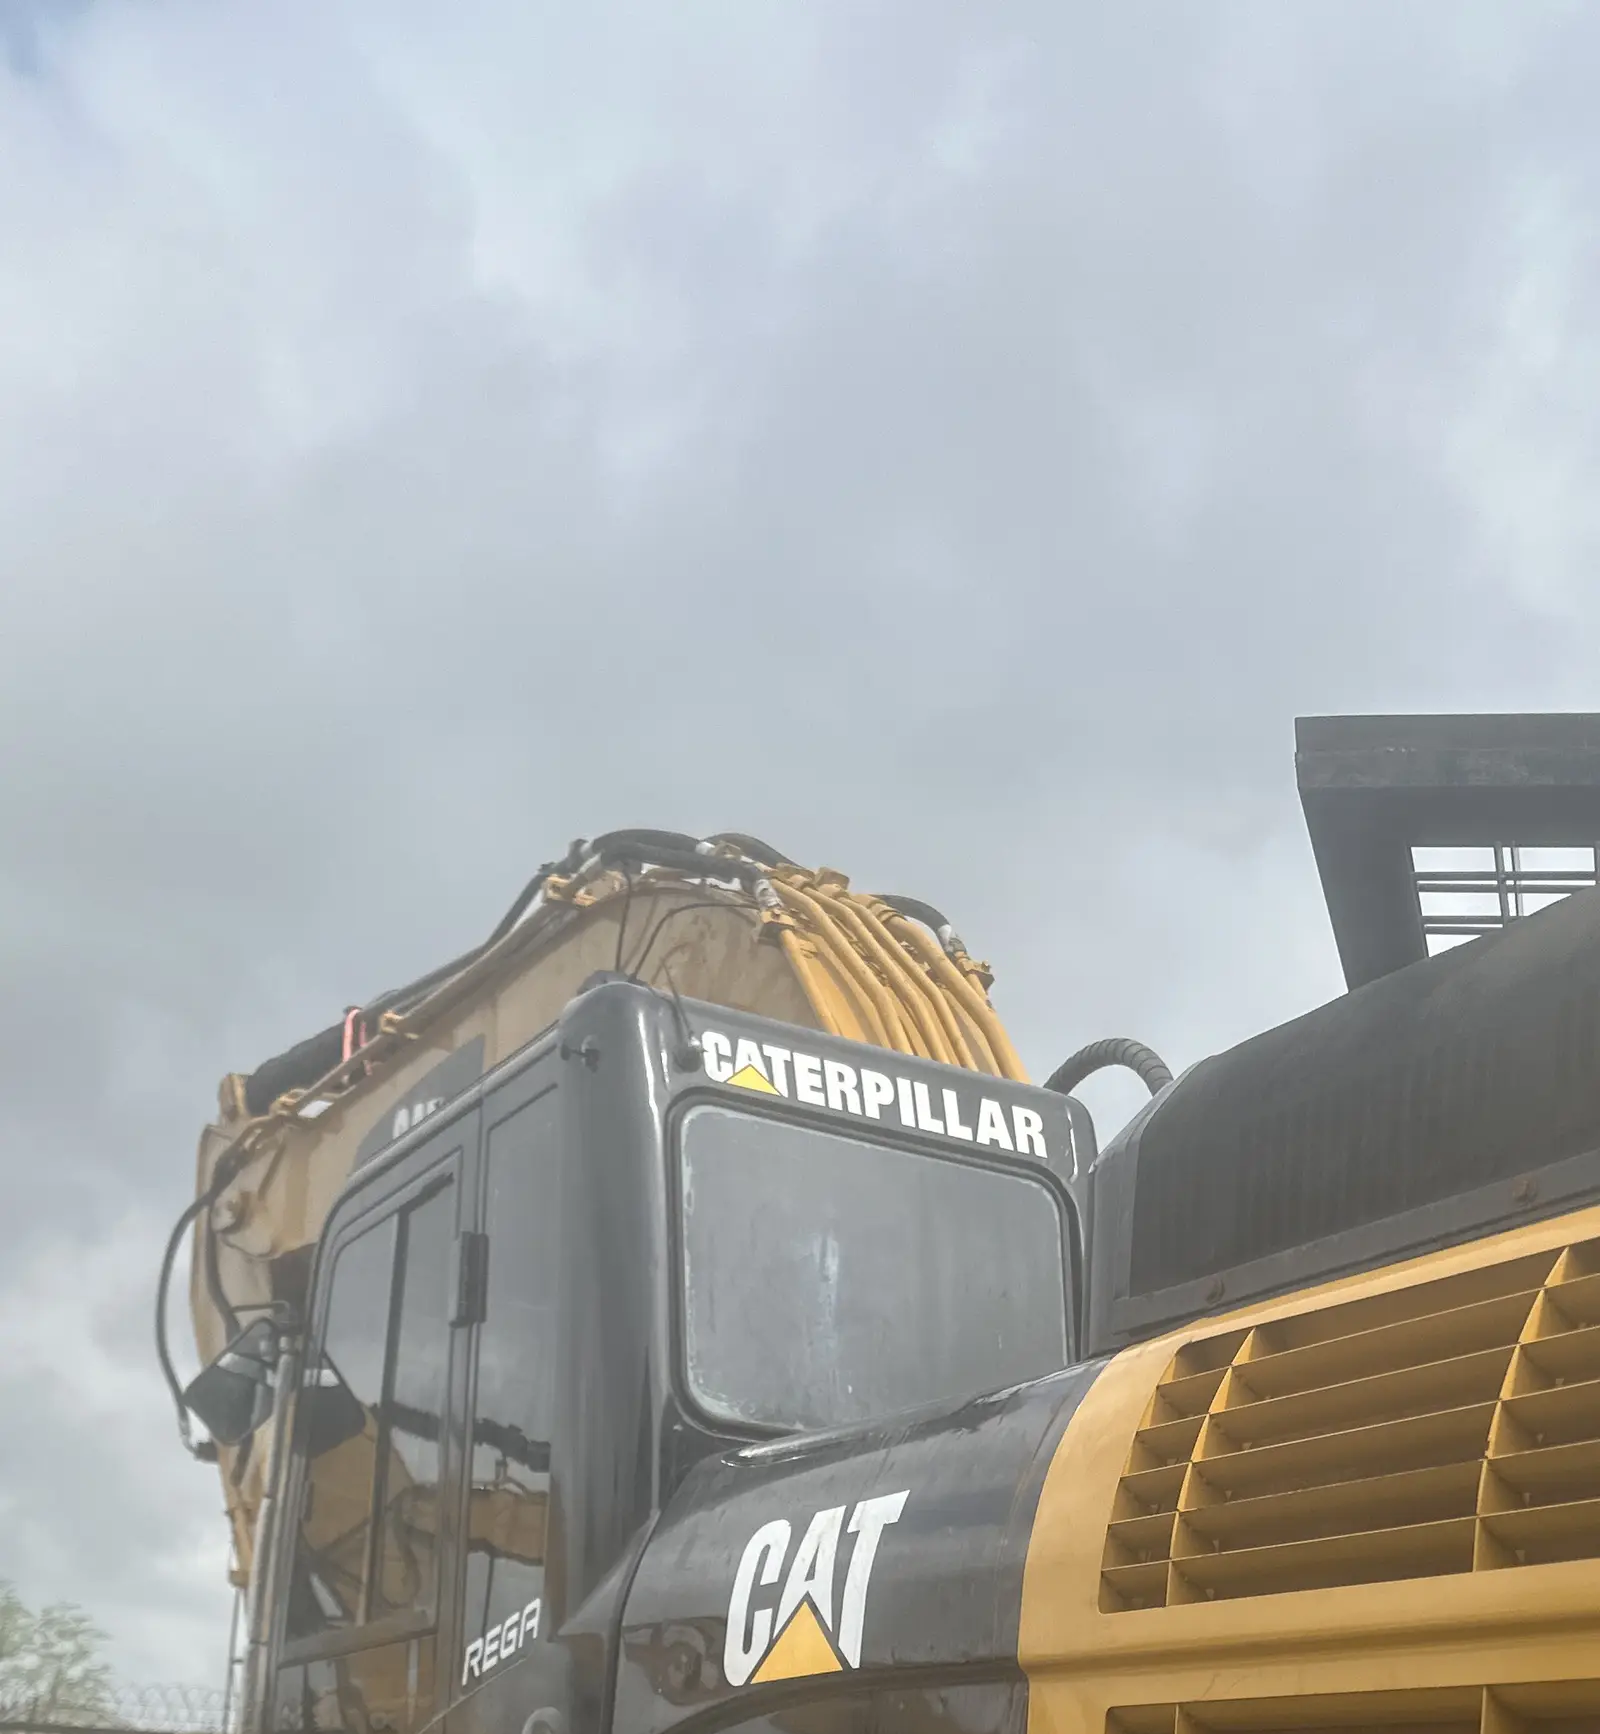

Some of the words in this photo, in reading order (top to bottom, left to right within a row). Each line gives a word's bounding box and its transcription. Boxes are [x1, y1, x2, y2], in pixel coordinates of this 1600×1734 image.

[701, 1030, 1048, 1159] CATERPILLAR
[462, 1597, 541, 1687] REGA
[723, 1489, 910, 1687] CAT
